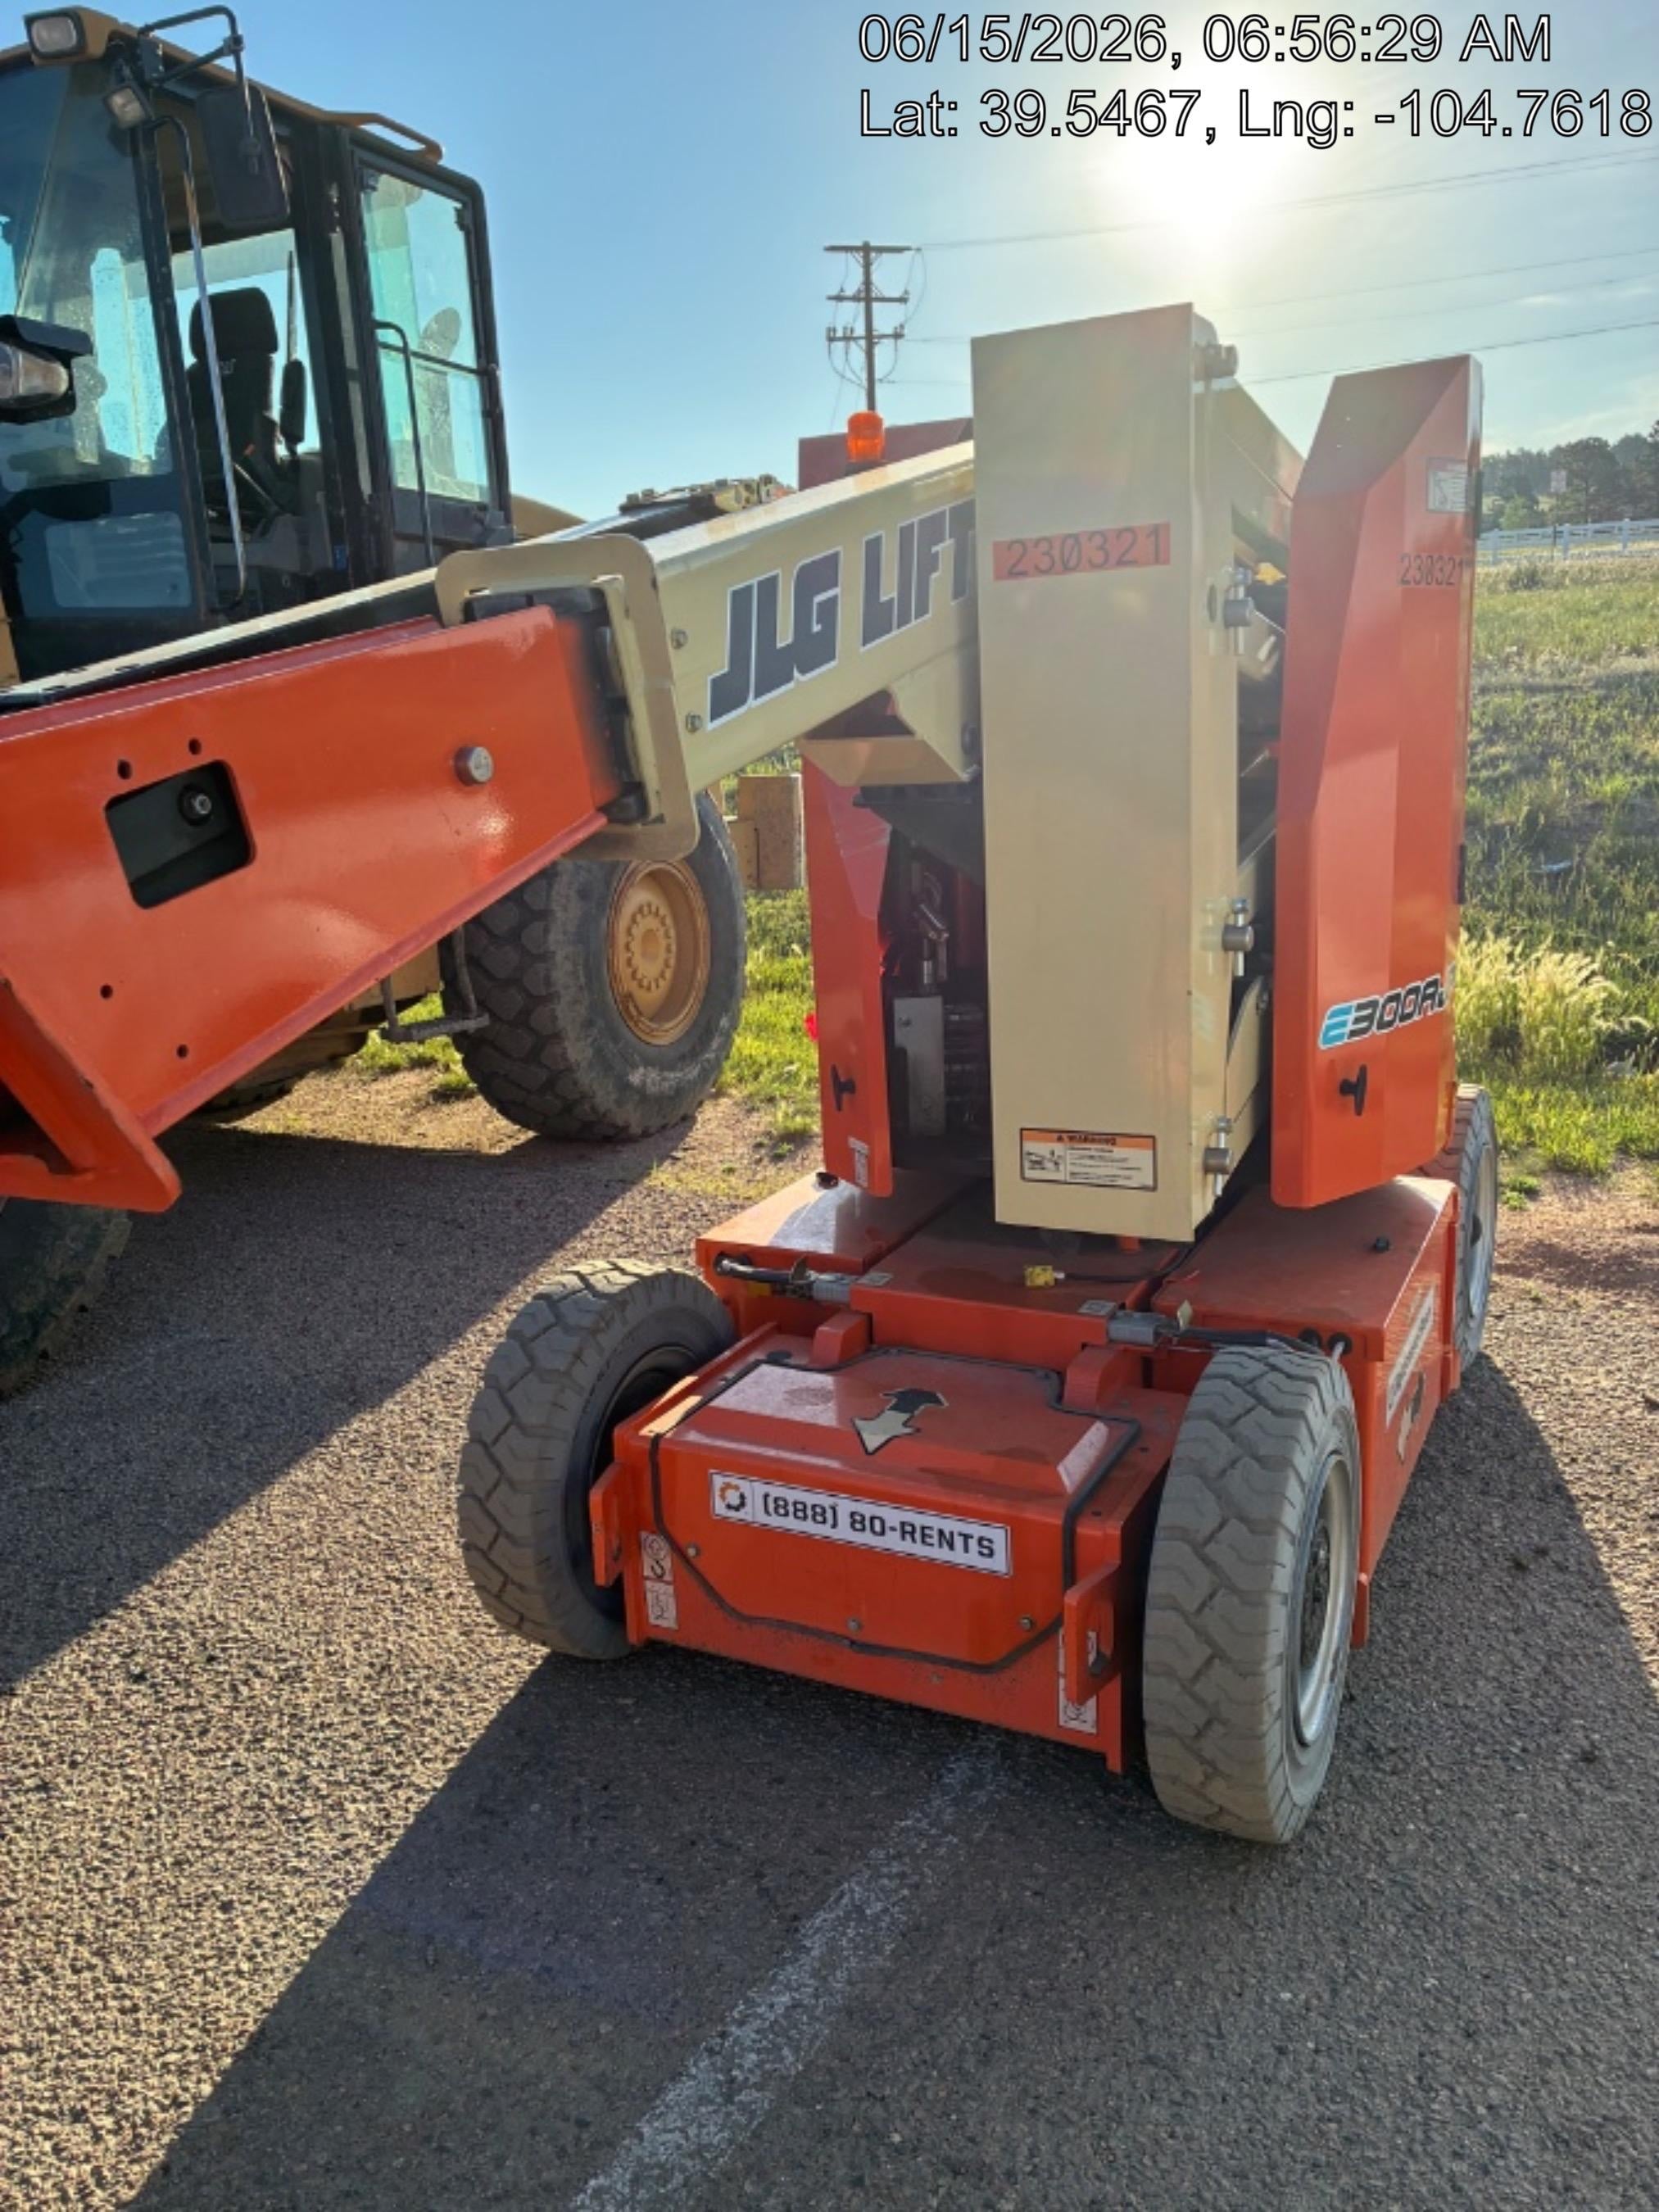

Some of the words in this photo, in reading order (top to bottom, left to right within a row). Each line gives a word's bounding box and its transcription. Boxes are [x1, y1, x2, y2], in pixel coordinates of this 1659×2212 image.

[1006, 524, 1162, 577] 230321
[707, 546, 841, 730] JLG
[860, 498, 976, 651] LIFT
[762, 1491, 838, 1530] (888)
[849, 1511, 996, 1559] 80-RENTS
